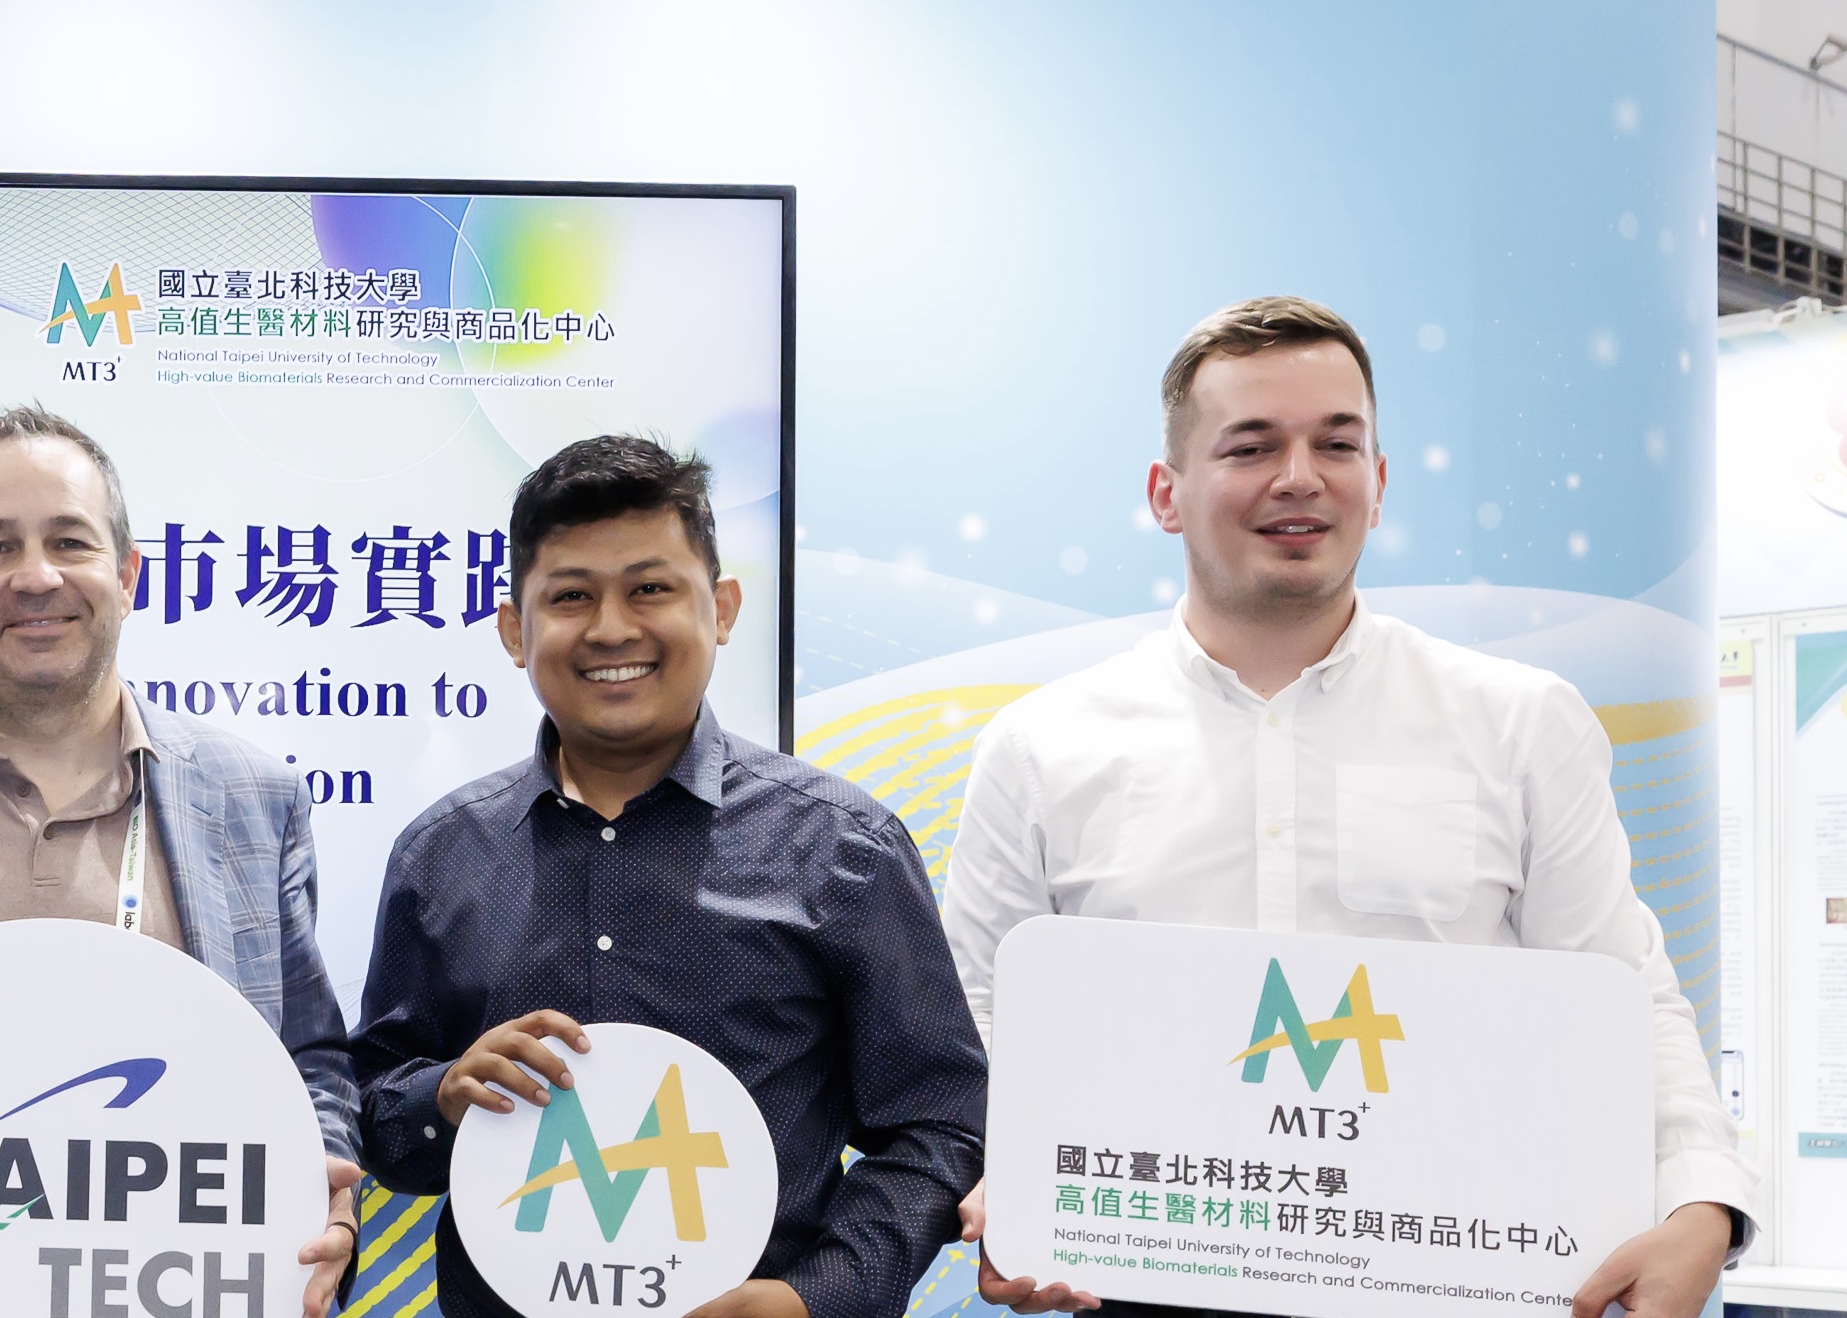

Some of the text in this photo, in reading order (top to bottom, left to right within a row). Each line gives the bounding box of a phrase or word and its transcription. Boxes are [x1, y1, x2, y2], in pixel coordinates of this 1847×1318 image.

[158, 269, 419, 302] 國立臺北科技大學
[157, 306, 616, 341] 高值生醫材料研究與商品化中心
[157, 349, 439, 367] National Taipei University of Technology
[157, 369, 616, 389] High-value Biomaterials Research and Commercialization Center
[126, 667, 410, 717] novation
[431, 671, 488, 718] to
[1055, 1144, 1349, 1198] 國立臺北科技大學
[1054, 1183, 1579, 1257] 高值生醫材料研究與商品化中心
[1054, 1227, 1371, 1270] National Taipei University of Technology
[1053, 1248, 1574, 1308] High-value Biomaterials Research and Commercialization Cente
